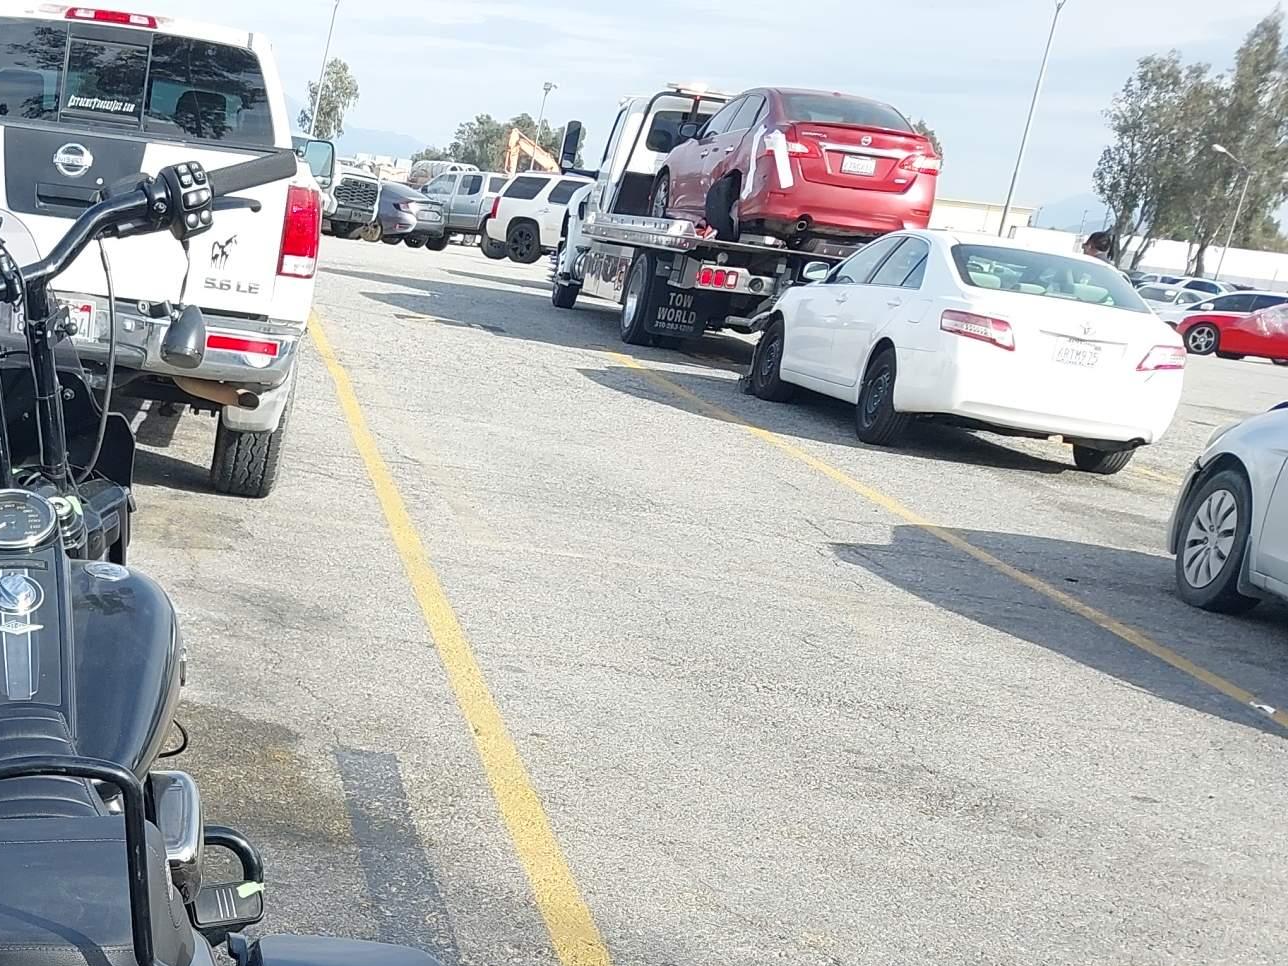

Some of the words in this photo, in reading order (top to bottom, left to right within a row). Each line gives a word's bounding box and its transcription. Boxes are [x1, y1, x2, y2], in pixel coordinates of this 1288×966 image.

[236, 281, 260, 294] LE
[669, 292, 694, 308] TOW
[657, 306, 697, 324] WORLD
